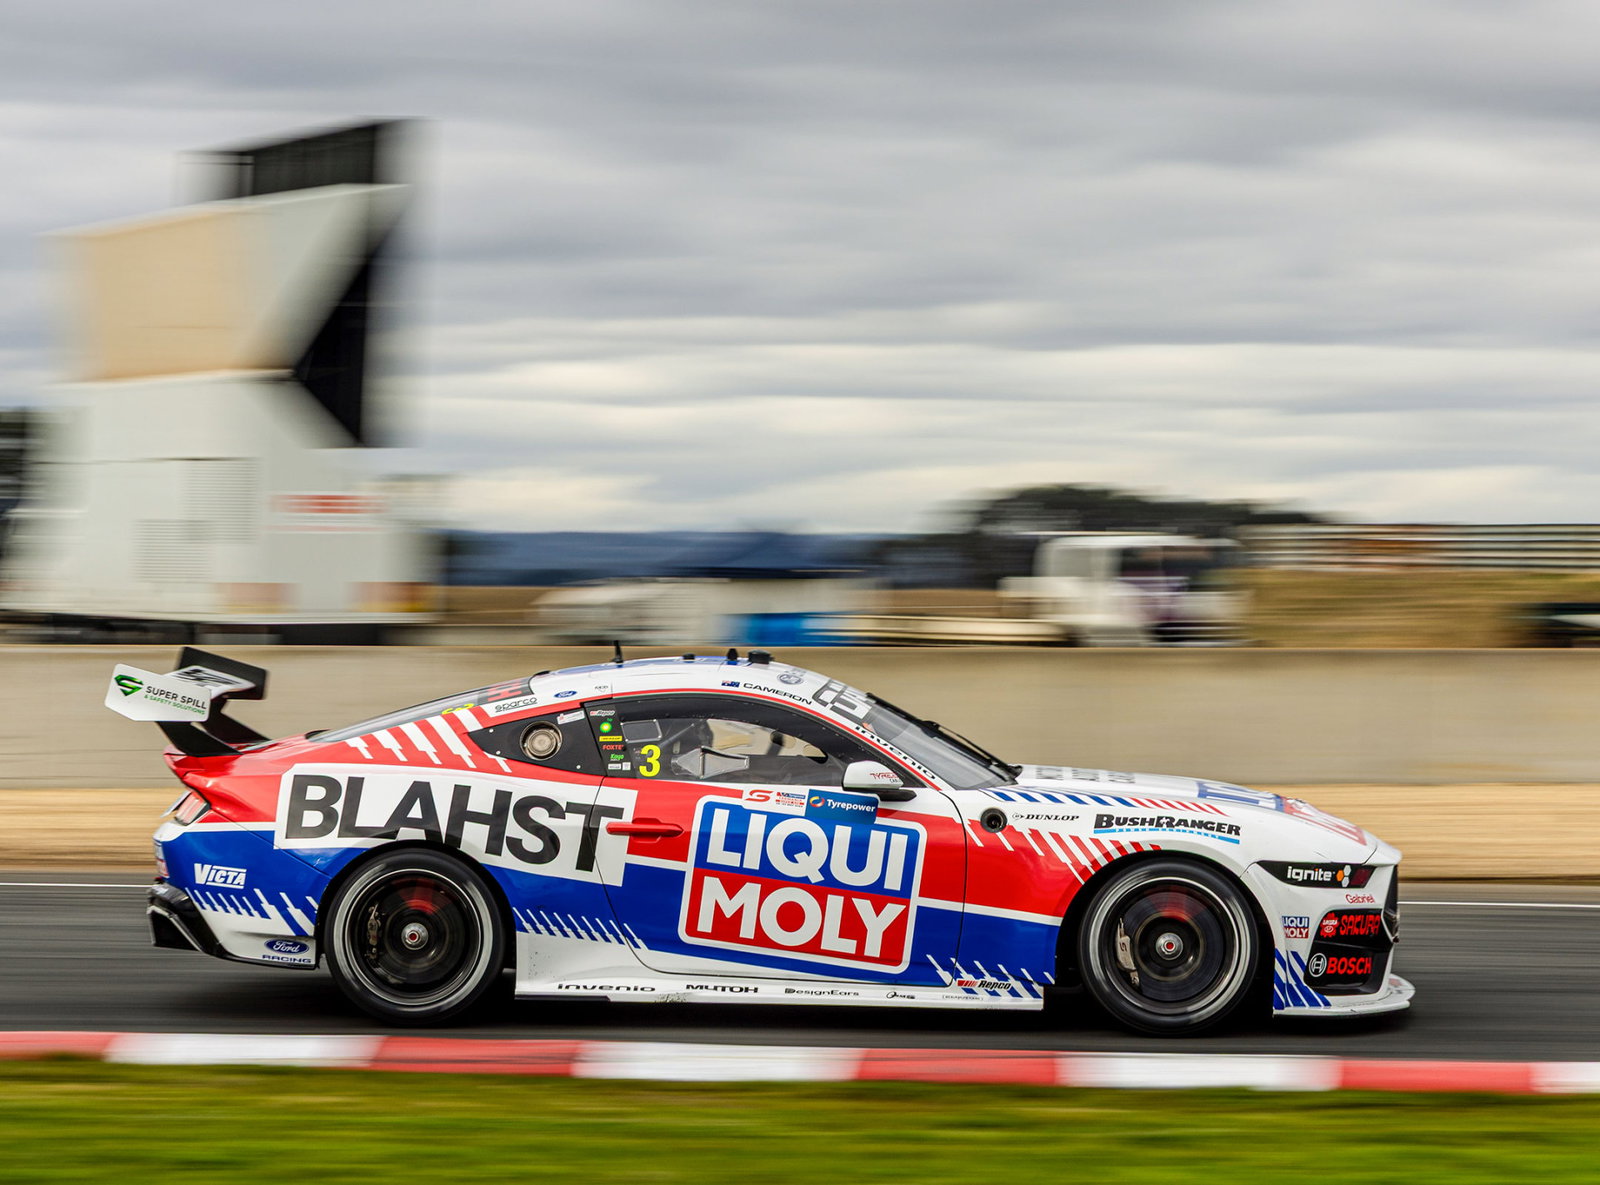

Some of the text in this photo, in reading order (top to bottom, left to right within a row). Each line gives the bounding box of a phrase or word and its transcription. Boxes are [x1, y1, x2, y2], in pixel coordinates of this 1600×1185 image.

[146, 685, 207, 710] SUPER SPILL
[743, 682, 812, 705] CAMERON
[150, 695, 171, 705] SAFETY
[172, 702, 206, 715] SOLUTIONS
[494, 696, 537, 713] sparco
[639, 744, 661, 777] 3
[855, 725, 936, 780] invenio
[827, 798, 876, 813] Tyrepower
[285, 774, 625, 873] BLAHST
[1025, 813, 1080, 822] DUNLOP
[706, 807, 909, 892] LIQUI
[1286, 865, 1332, 882] ignite
[1345, 892, 1375, 904] Gabriel
[696, 875, 907, 958] MOLY
[1339, 914, 1381, 936] SAKURA
[272, 940, 300, 953] Ford
[262, 954, 312, 964] RACING
[1326, 957, 1372, 975] BOSCH
[557, 983, 656, 993] invenio
[685, 984, 759, 994] MUTOH
[978, 979, 1011, 990] Repco
